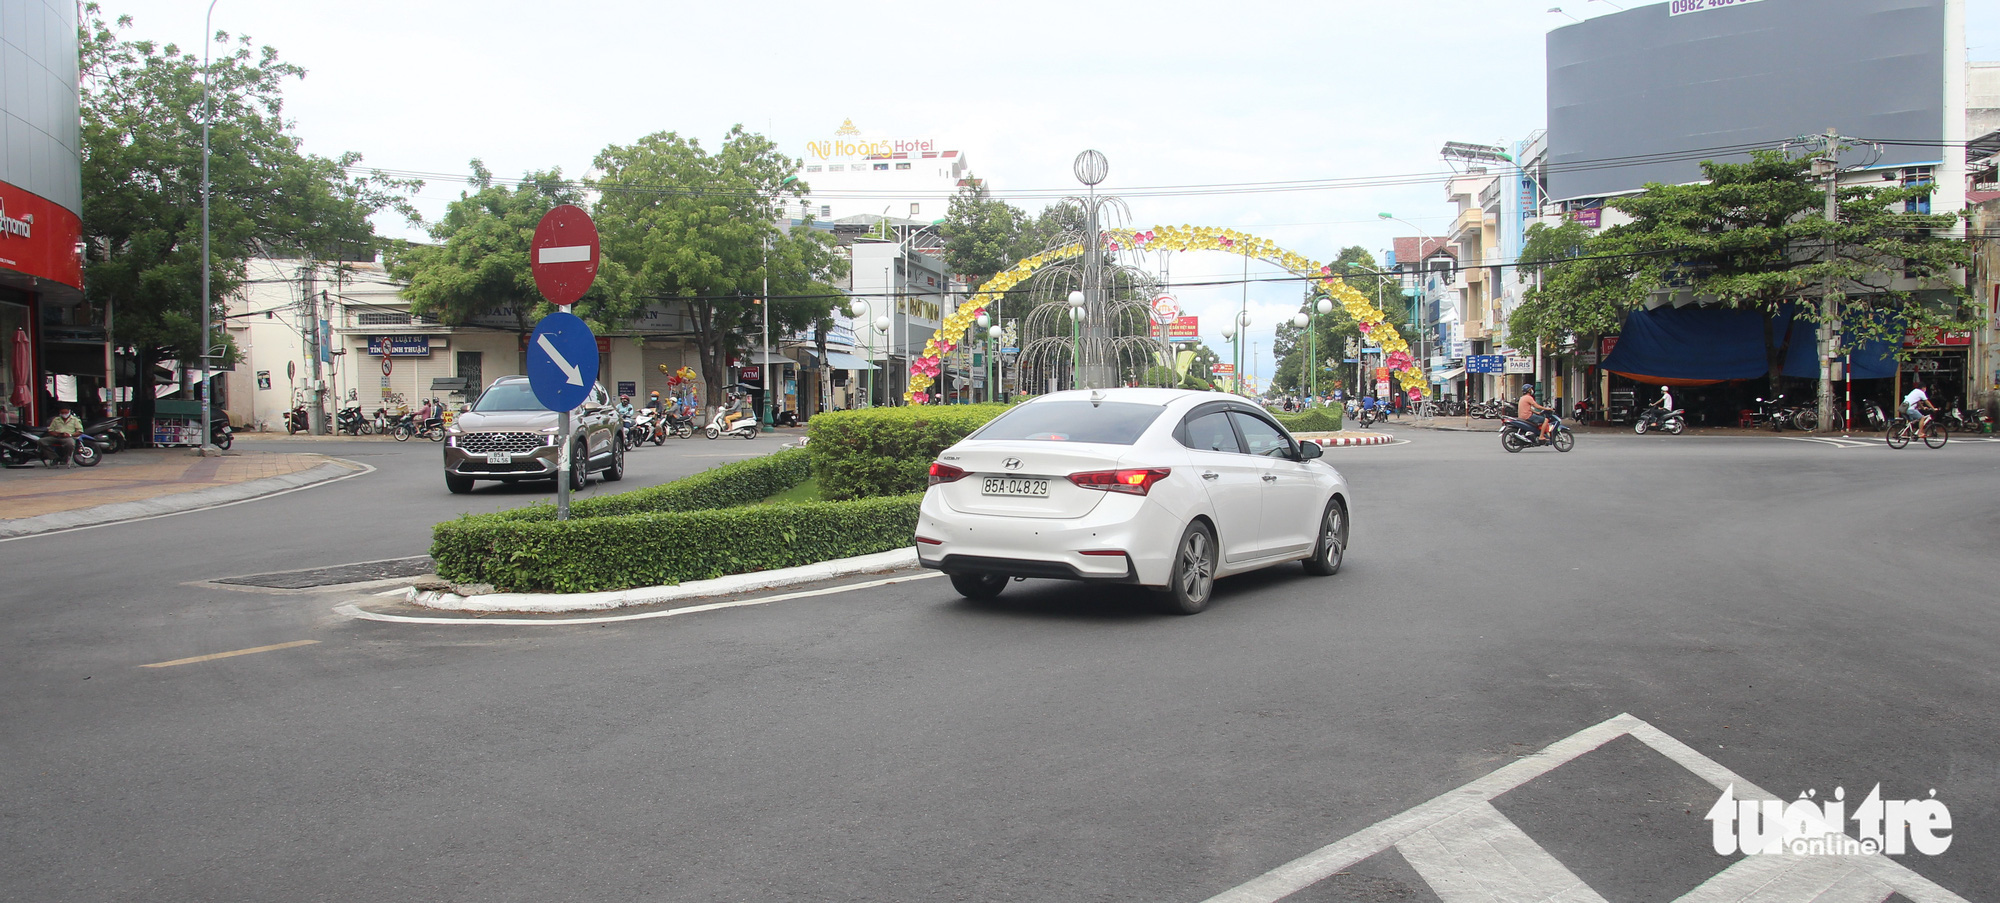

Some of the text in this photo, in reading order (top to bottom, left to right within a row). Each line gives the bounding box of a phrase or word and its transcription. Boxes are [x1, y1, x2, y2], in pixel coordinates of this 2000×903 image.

[1672, 0, 1704, 14] 0982
[894, 139, 933, 151] Hotel
[404, 346, 426, 354] THUẬN
